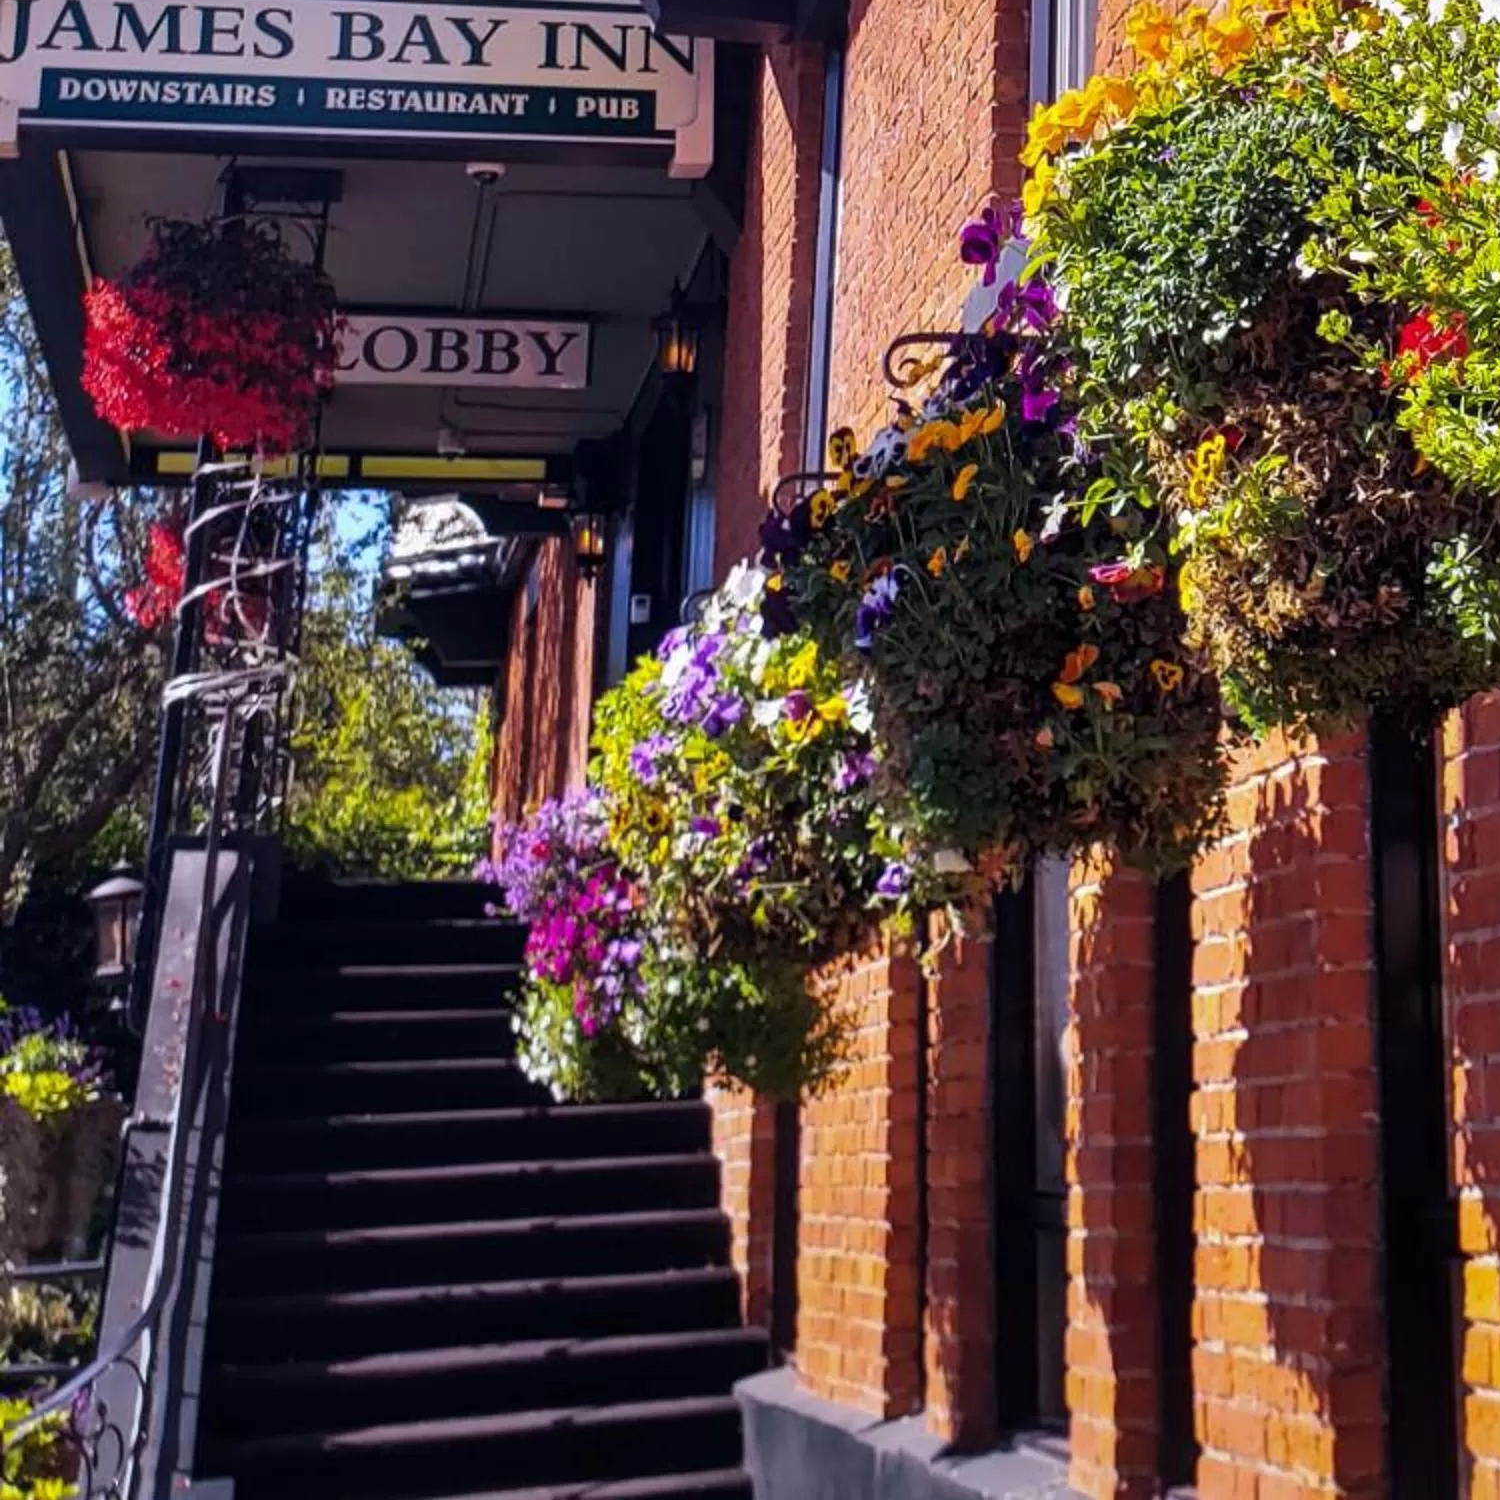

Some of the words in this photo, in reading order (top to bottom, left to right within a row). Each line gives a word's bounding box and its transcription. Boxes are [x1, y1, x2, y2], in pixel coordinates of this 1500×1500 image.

[327, 11, 509, 67] BAY
[537, 21, 694, 75] INN
[58, 77, 276, 107] DOWNSTAIRS
[325, 87, 529, 115] RESTAURANT
[576, 97, 640, 119] PUB
